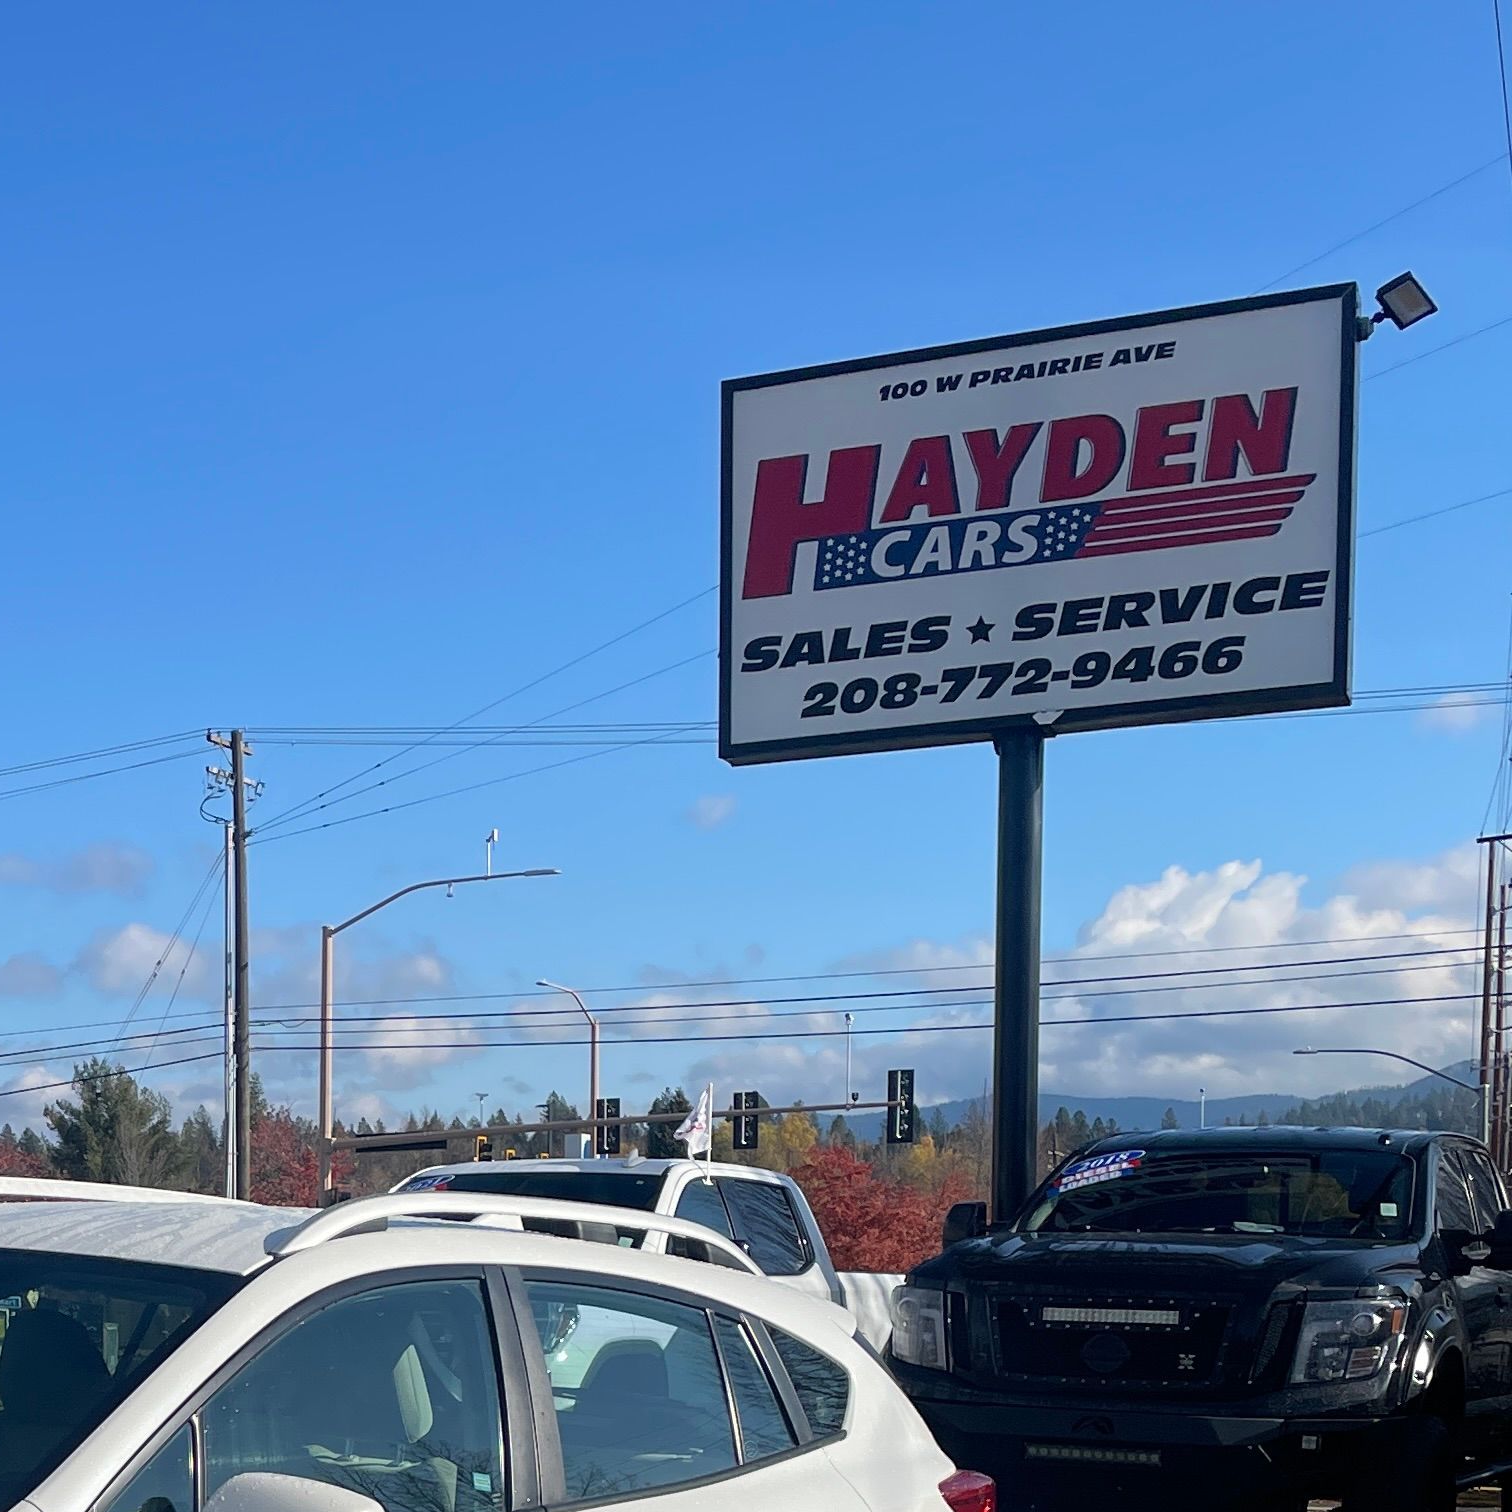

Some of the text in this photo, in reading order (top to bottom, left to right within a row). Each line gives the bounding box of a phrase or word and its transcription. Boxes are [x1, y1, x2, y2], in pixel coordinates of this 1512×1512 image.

[880, 341, 1176, 401] 100 W PRAIRIE AVE
[742, 387, 1298, 599] HAYDEN
[870, 513, 1043, 578] CARS
[740, 570, 1330, 673] SALES SERVICE
[800, 636, 1246, 719] 208-772-9466
[1076, 1152, 1130, 1172] 2018
